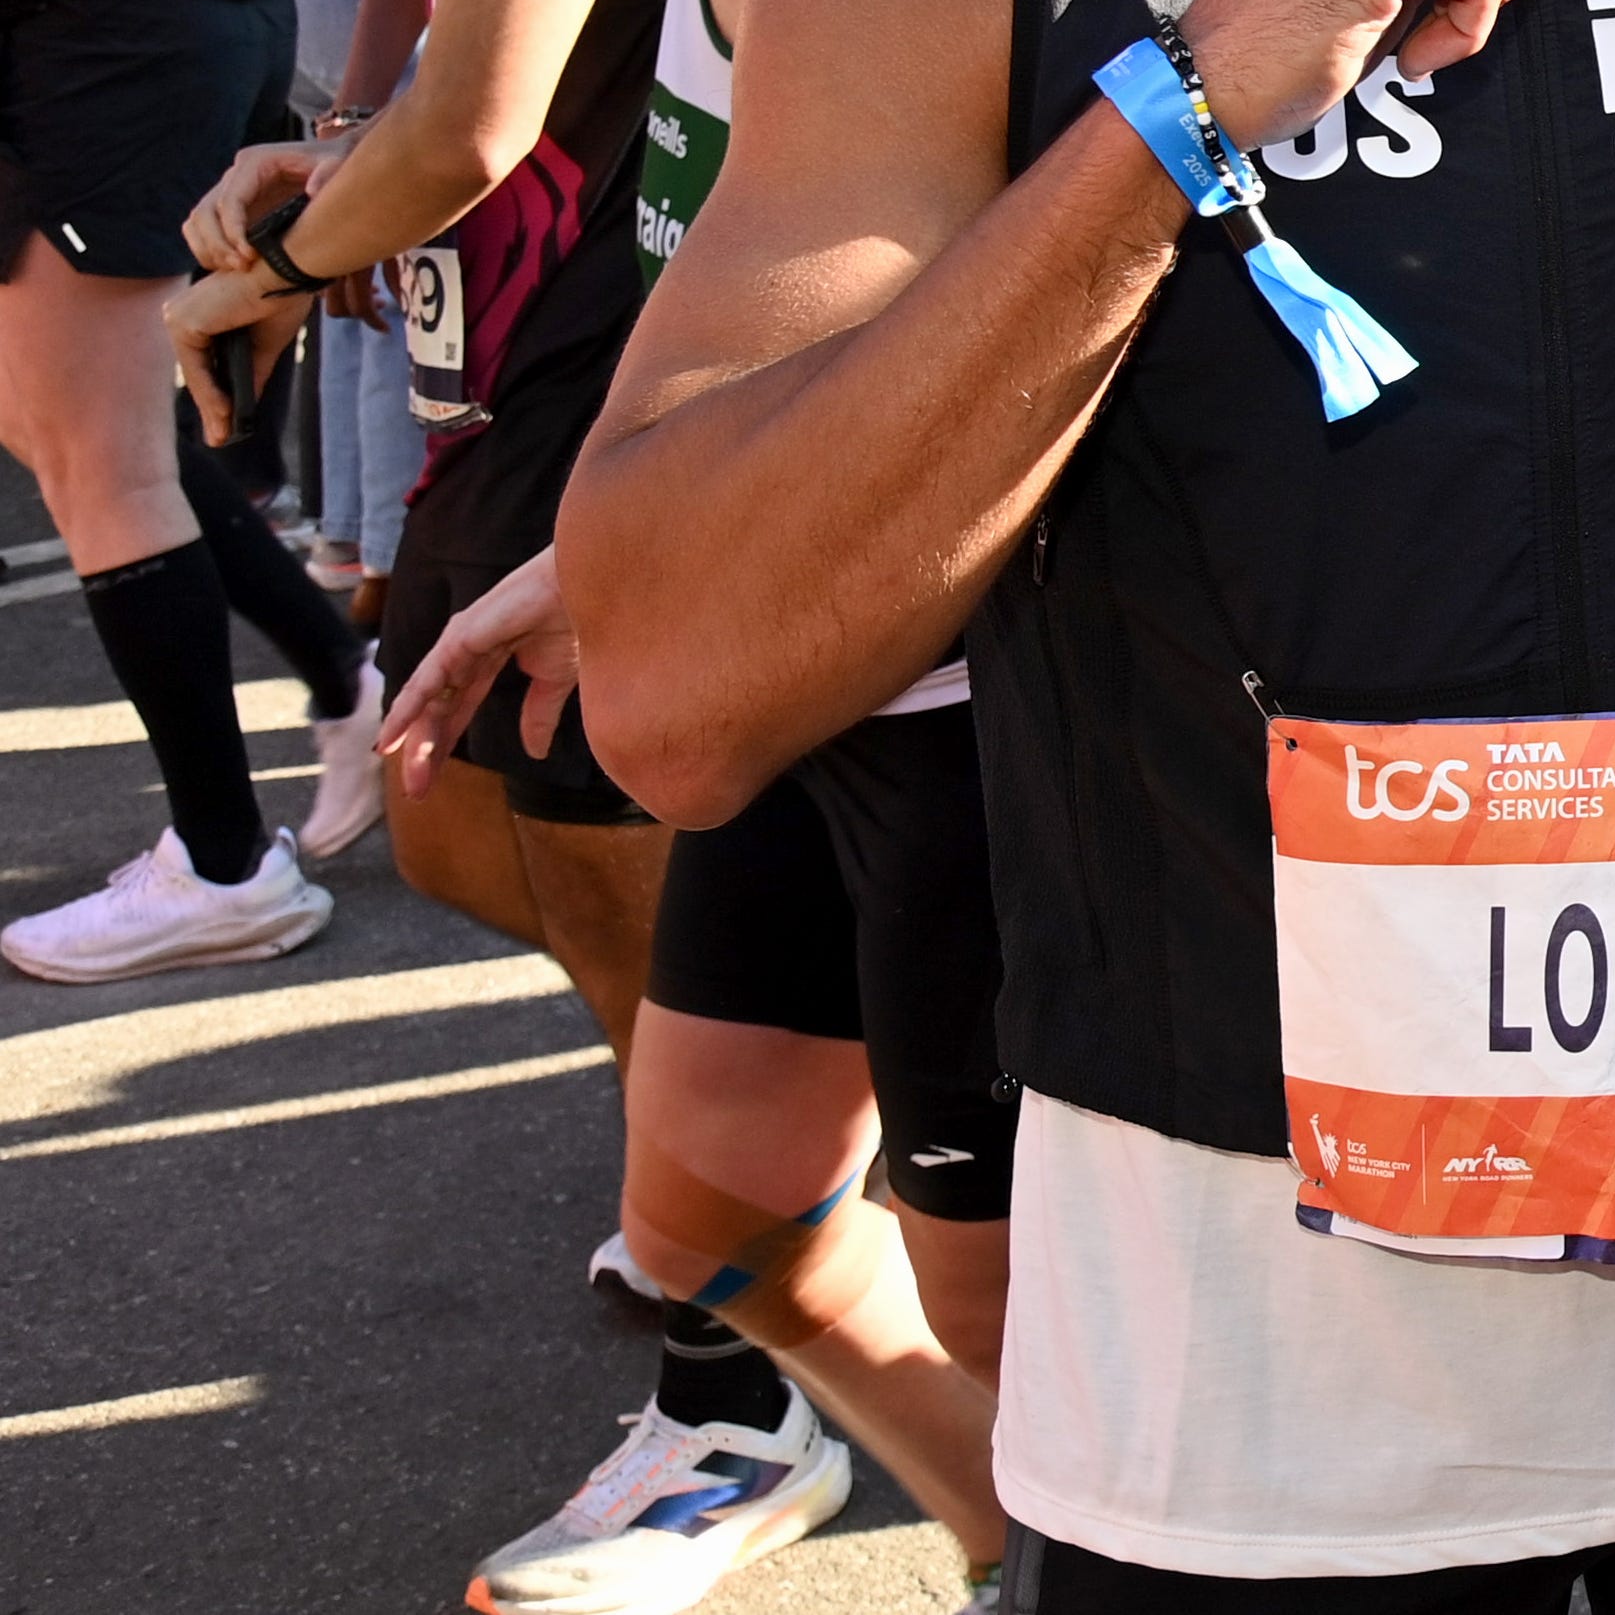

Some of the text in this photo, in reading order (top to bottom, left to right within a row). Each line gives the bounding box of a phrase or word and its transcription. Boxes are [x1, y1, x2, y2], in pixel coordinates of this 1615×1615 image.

[1182, 154, 1213, 188] 2025
[1486, 742, 1566, 765] TATA
[1343, 743, 1472, 822] tcs
[1486, 796, 1605, 821] SERVICES
[1346, 1138, 1368, 1155] tcs
[1347, 1155, 1412, 1172] NEW YORK CITY
[1347, 1164, 1396, 1179] MARATHON
